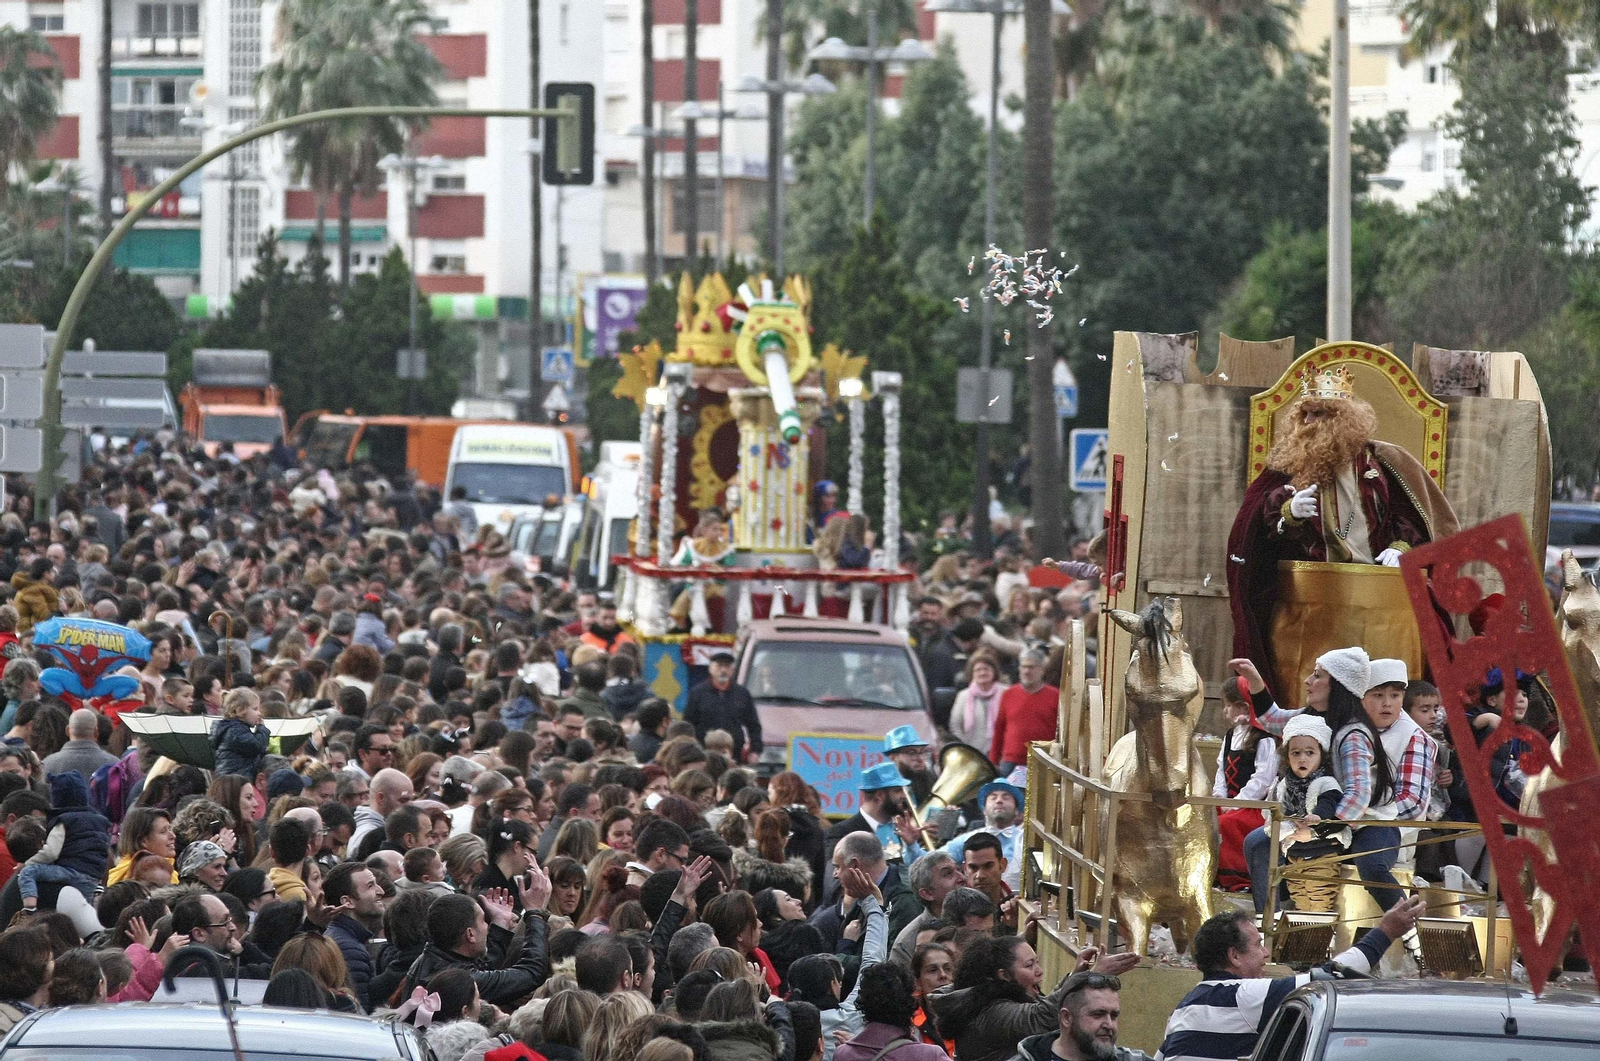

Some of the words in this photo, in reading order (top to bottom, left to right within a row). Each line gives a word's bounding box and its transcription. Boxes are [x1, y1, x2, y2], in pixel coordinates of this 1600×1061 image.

[54, 626, 126, 655] SPIDER-MAN
[797, 741, 884, 769] Novia
[826, 769, 853, 782] del
